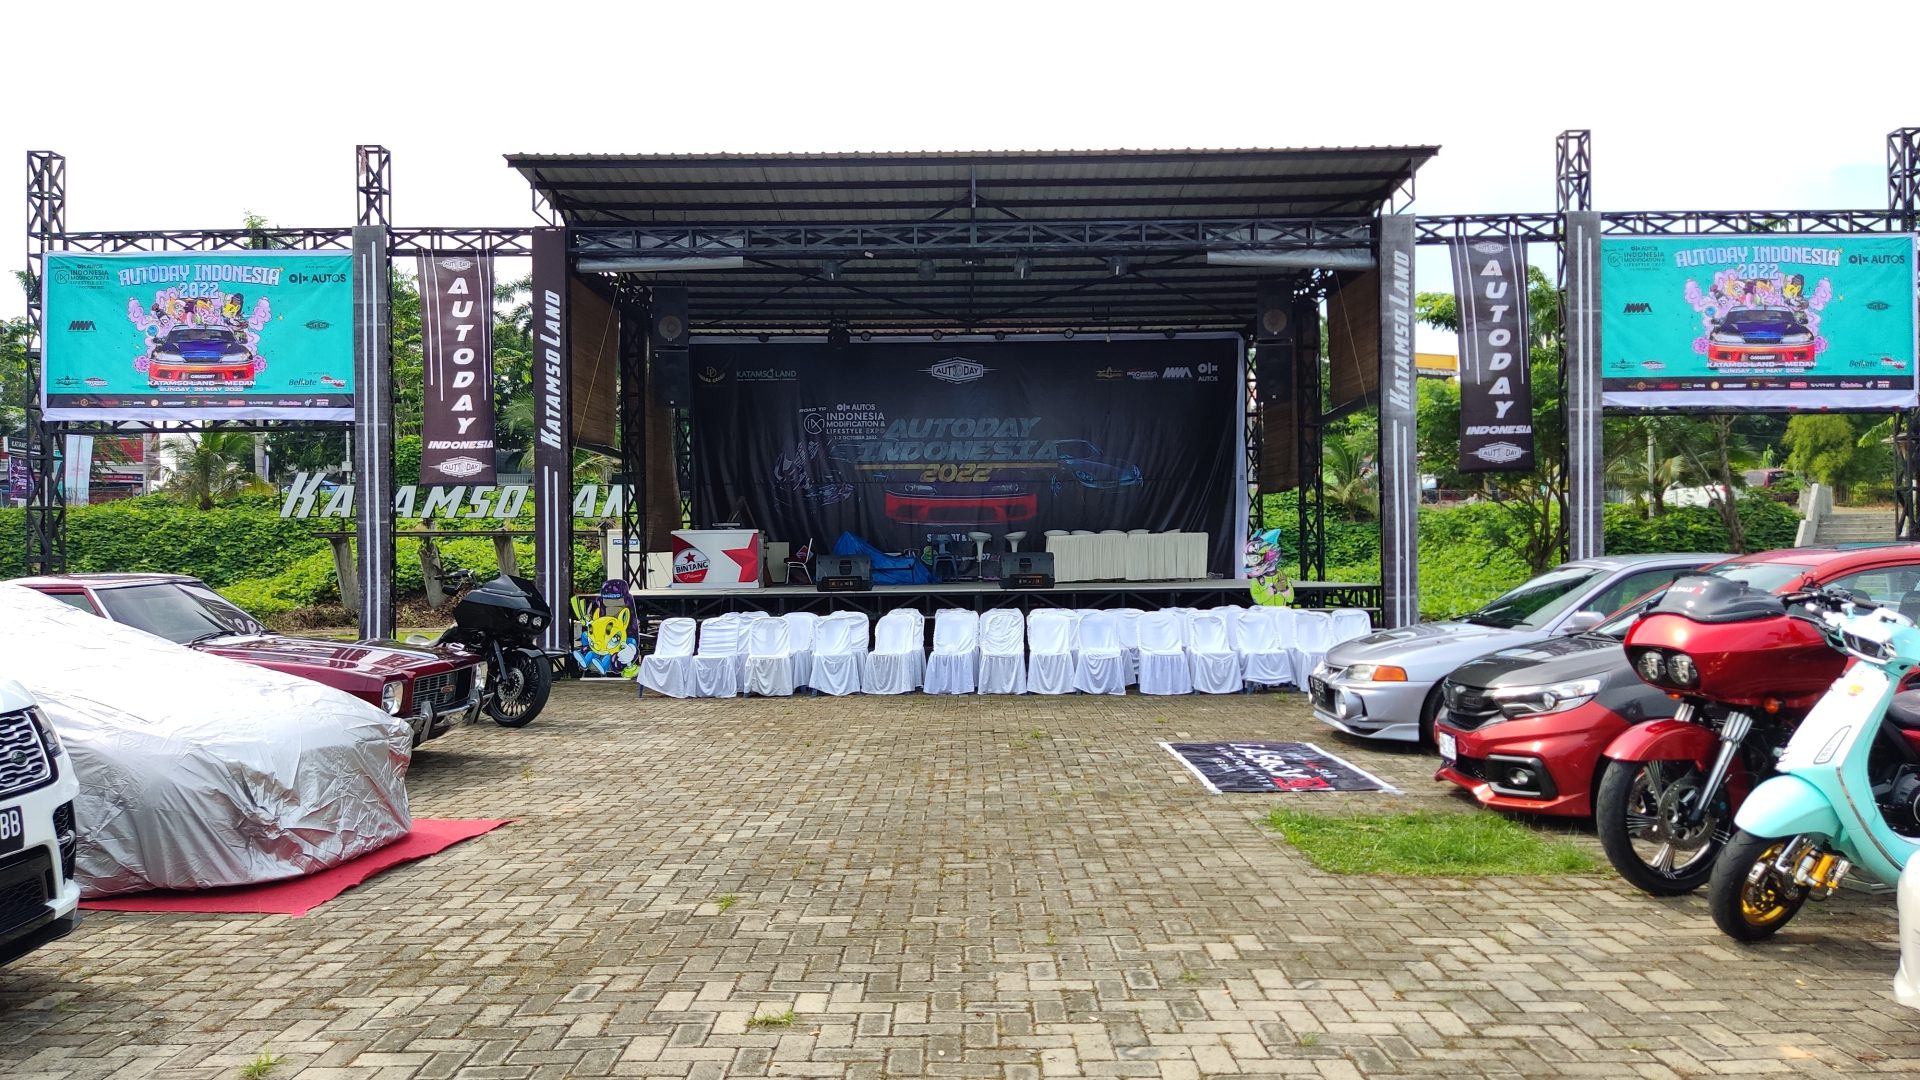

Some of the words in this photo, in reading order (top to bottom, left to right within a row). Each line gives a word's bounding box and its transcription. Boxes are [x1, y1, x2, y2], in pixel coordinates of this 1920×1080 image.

[1675, 245, 1749, 268] AUTODAY
[1753, 245, 1840, 267] INDONESIA
[1871, 255, 1905, 264] AUTOS
[119, 264, 190, 286] AUTODAY
[193, 264, 280, 286] INDONESIA
[311, 273, 347, 283] AUTOS
[1388, 250, 1410, 308] LAND
[1738, 264, 1779, 280] 2022
[179, 282, 219, 299] 2022
[540, 290, 561, 348] LAND
[1480, 260, 1514, 419] AUTODAY
[448, 277, 476, 434] AUTODAY
[1389, 309, 1410, 410] KATAMSO
[775, 370, 797, 378] LAND
[540, 348, 561, 450] KATAMSO
[826, 412, 885, 420] INDONESIA
[883, 416, 1041, 439] AUTODAY
[1465, 424, 1532, 435] INDONESIA
[428, 440, 494, 449] INDONESIA
[854, 439, 1059, 462] INDONESIA
[920, 463, 995, 483] 2022
[280, 472, 529, 518] KAAMSO
[676, 561, 708, 573] BINTANG
